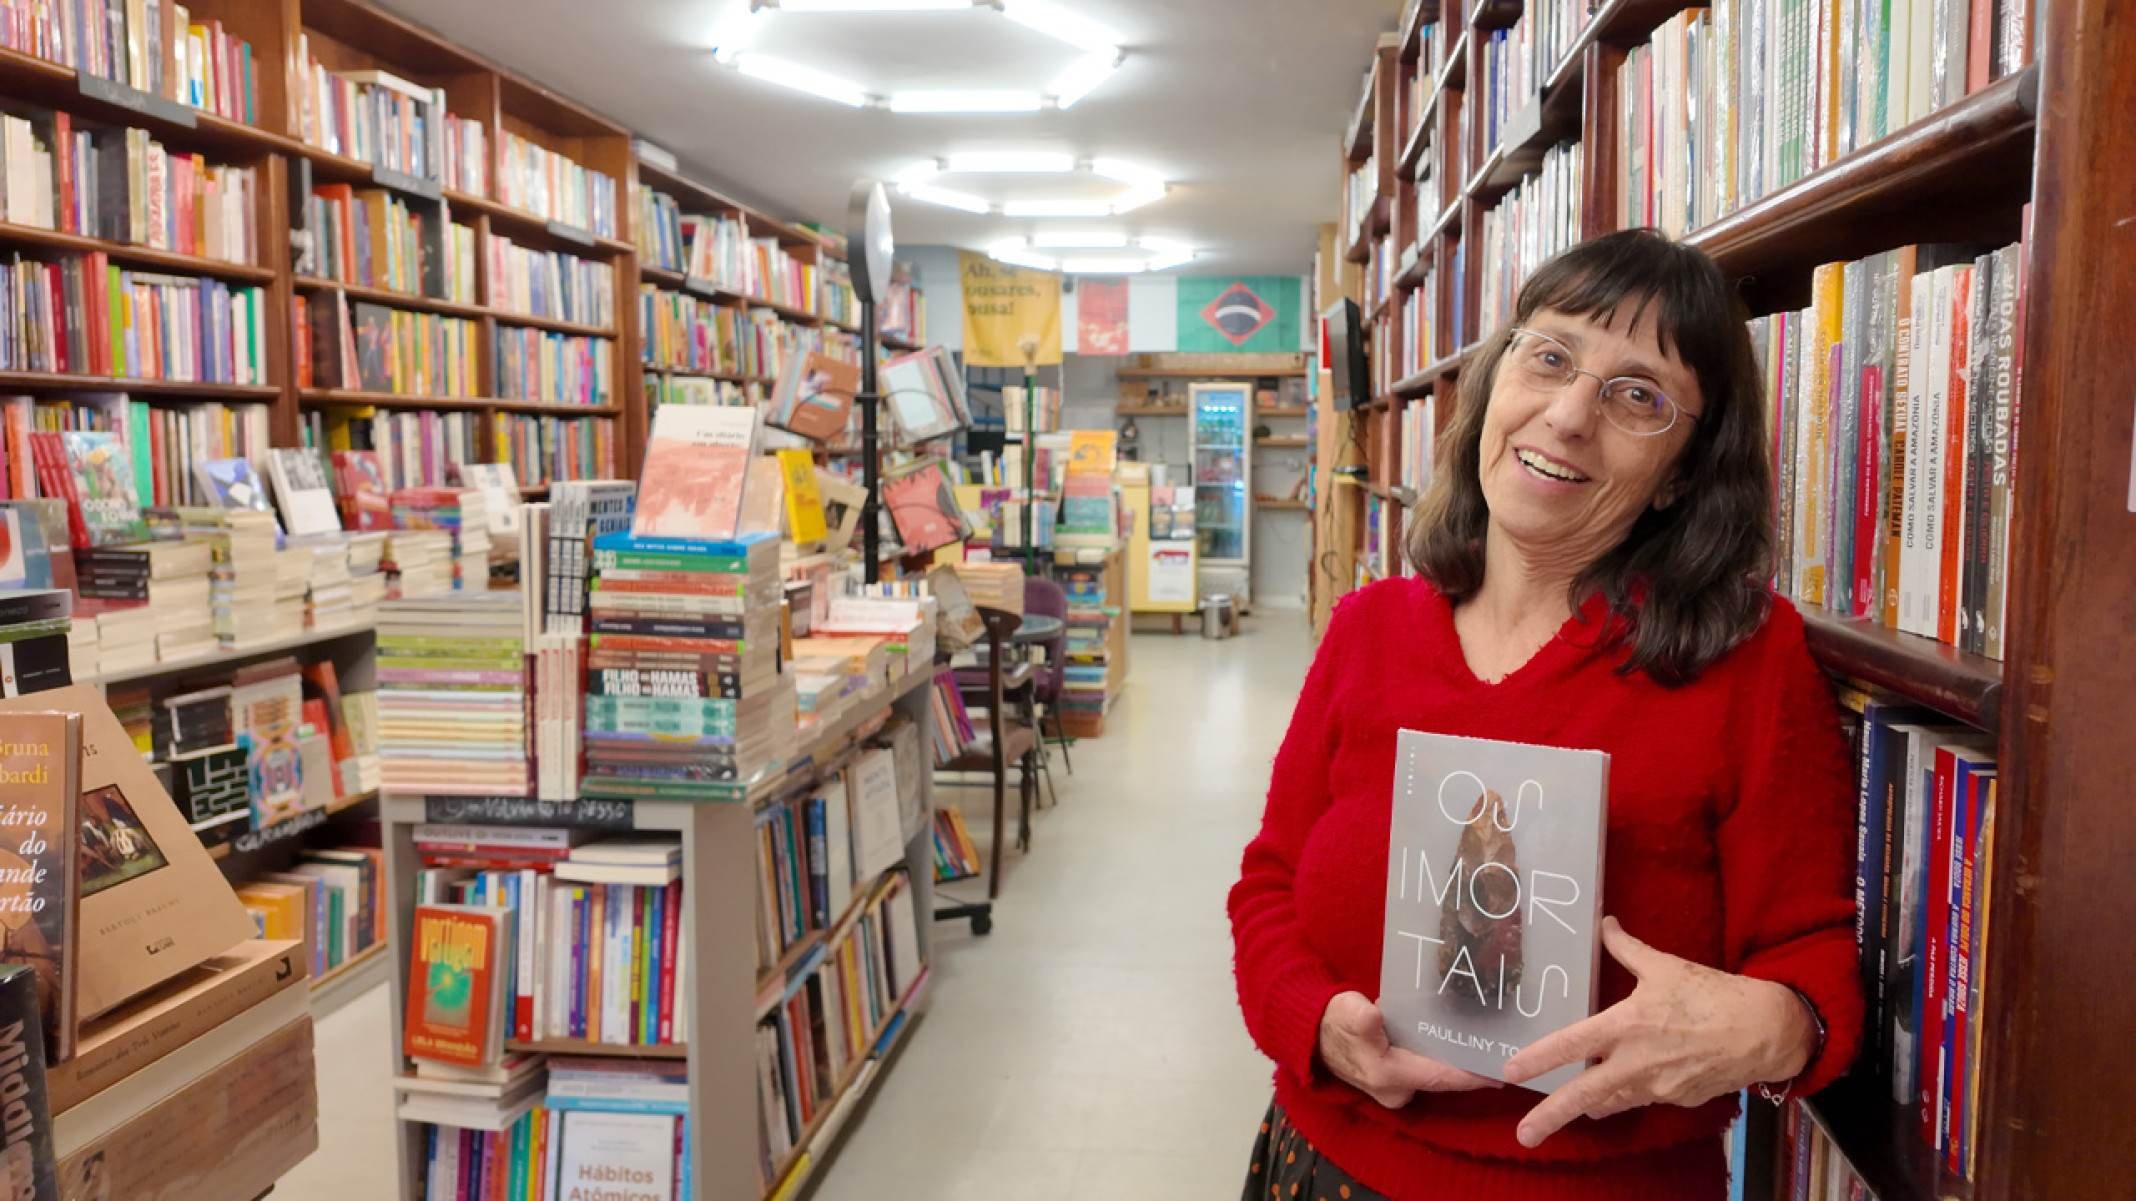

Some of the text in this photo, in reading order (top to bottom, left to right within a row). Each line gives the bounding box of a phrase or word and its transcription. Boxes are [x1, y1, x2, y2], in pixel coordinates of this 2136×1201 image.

[1999, 273, 2015, 348] VIDAS
[1896, 329, 1910, 386] CONTRATO
[1894, 392, 1908, 432] SEXUAL
[1994, 356, 2011, 486] ROUBADAS
[1893, 440, 1905, 480] CAROLE
[1911, 457, 1917, 465] A
[1929, 456, 1936, 464] A
[1909, 467, 1917, 511] SALVAR
[1927, 467, 1936, 511] SALVAR
[1891, 486, 1904, 537] PATEMAN
[1907, 514, 1915, 548] COMO
[1926, 514, 1934, 550] COMO
[603, 669, 639, 683] FILHO
[651, 670, 698, 684] HAMAS
[604, 683, 640, 696] FILHO
[651, 684, 700, 697] HAMAS
[0, 740, 48, 756] runa
[1438, 770, 1543, 832] OS
[19, 830, 46, 855] do
[1400, 847, 1580, 935] IMOR
[1398, 931, 1568, 1018] TAIS
[1956, 982, 1967, 1012] SOUZA
[1418, 1022, 1521, 1057] PAULLINY TO
[578, 1163, 654, 1185] Hábitos
